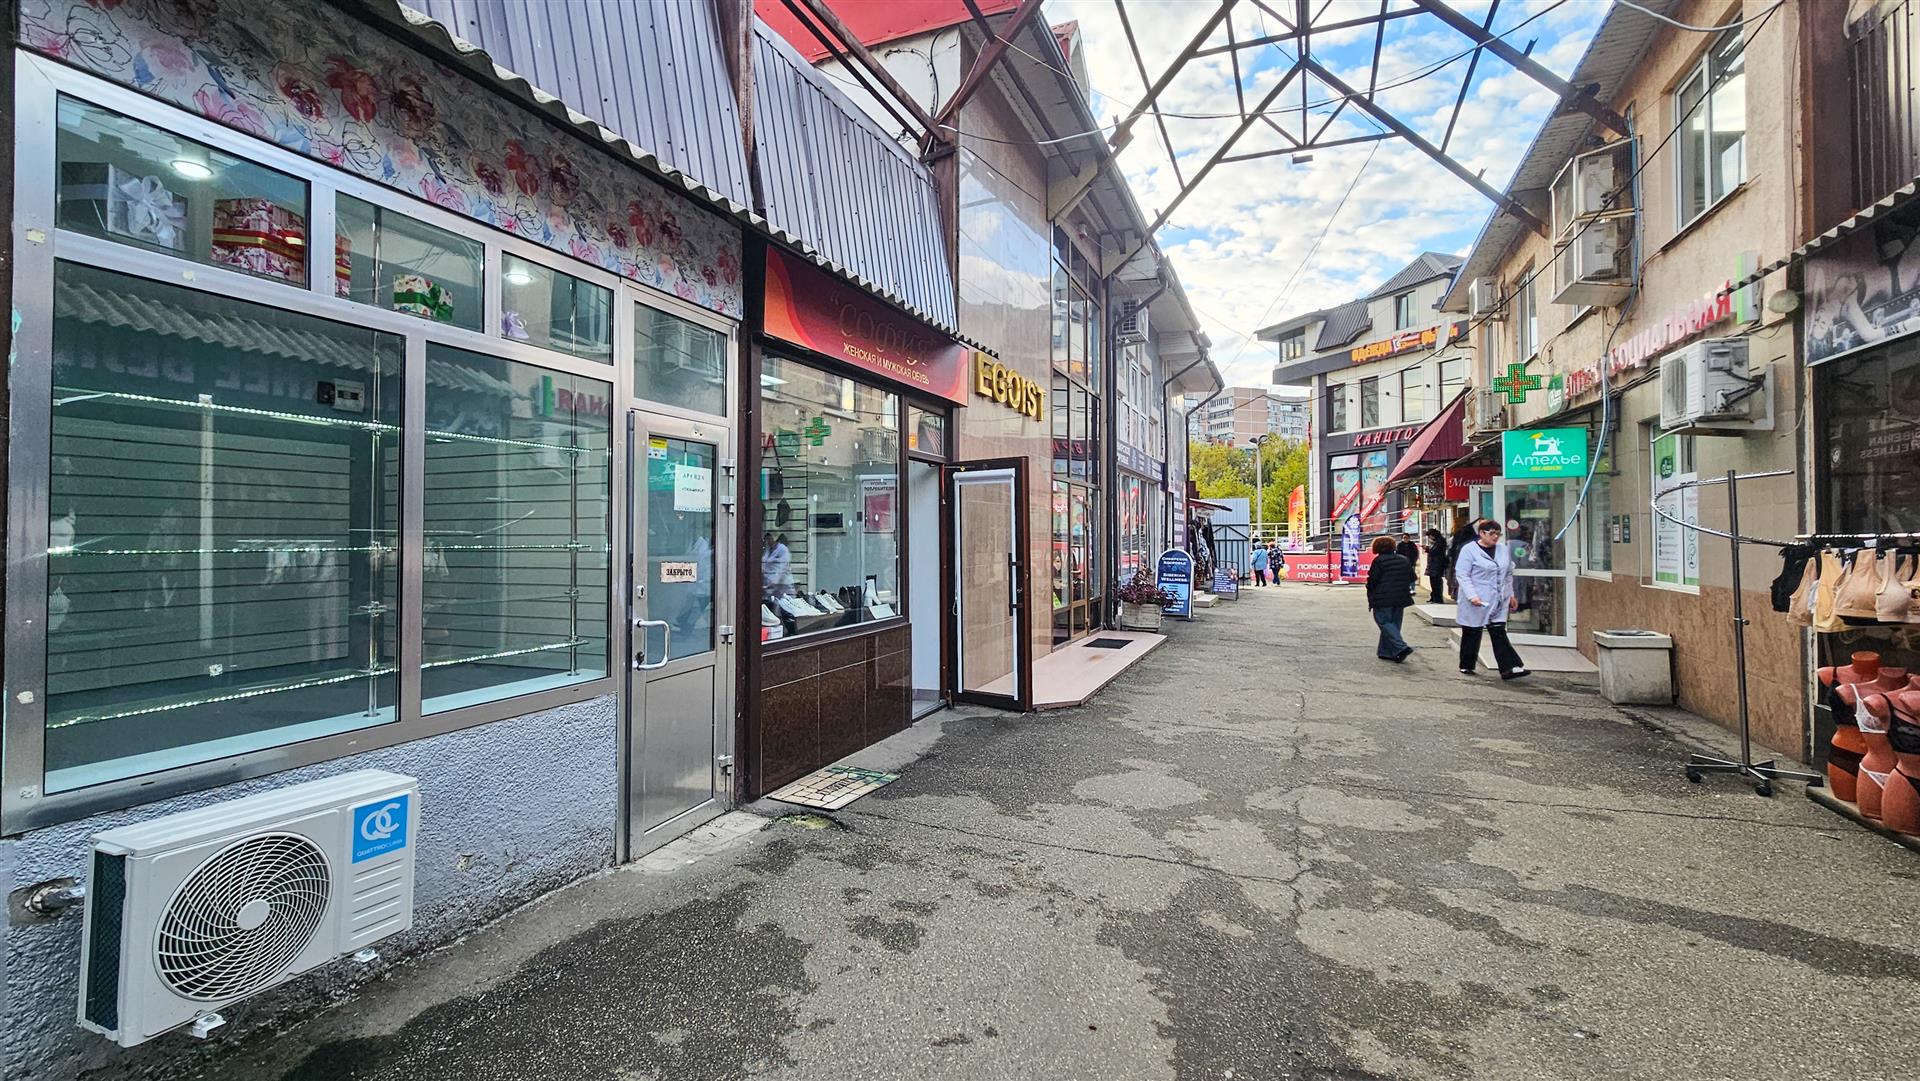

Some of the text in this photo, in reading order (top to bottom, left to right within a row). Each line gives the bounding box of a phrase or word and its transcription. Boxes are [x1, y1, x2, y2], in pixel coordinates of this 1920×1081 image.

[1609, 279, 1731, 374] СОЦИАЛЬНАЯ
[843, 342, 877, 365] ЖЕНСКАЯ
[882, 358, 912, 379] МУЖСКАЯ
[911, 369, 930, 385] ОБУВЬ
[974, 352, 1047, 421] EGOIST
[1512, 454, 1581, 466] Ателье
[665, 568, 693, 577] ЗАКРЫТО
